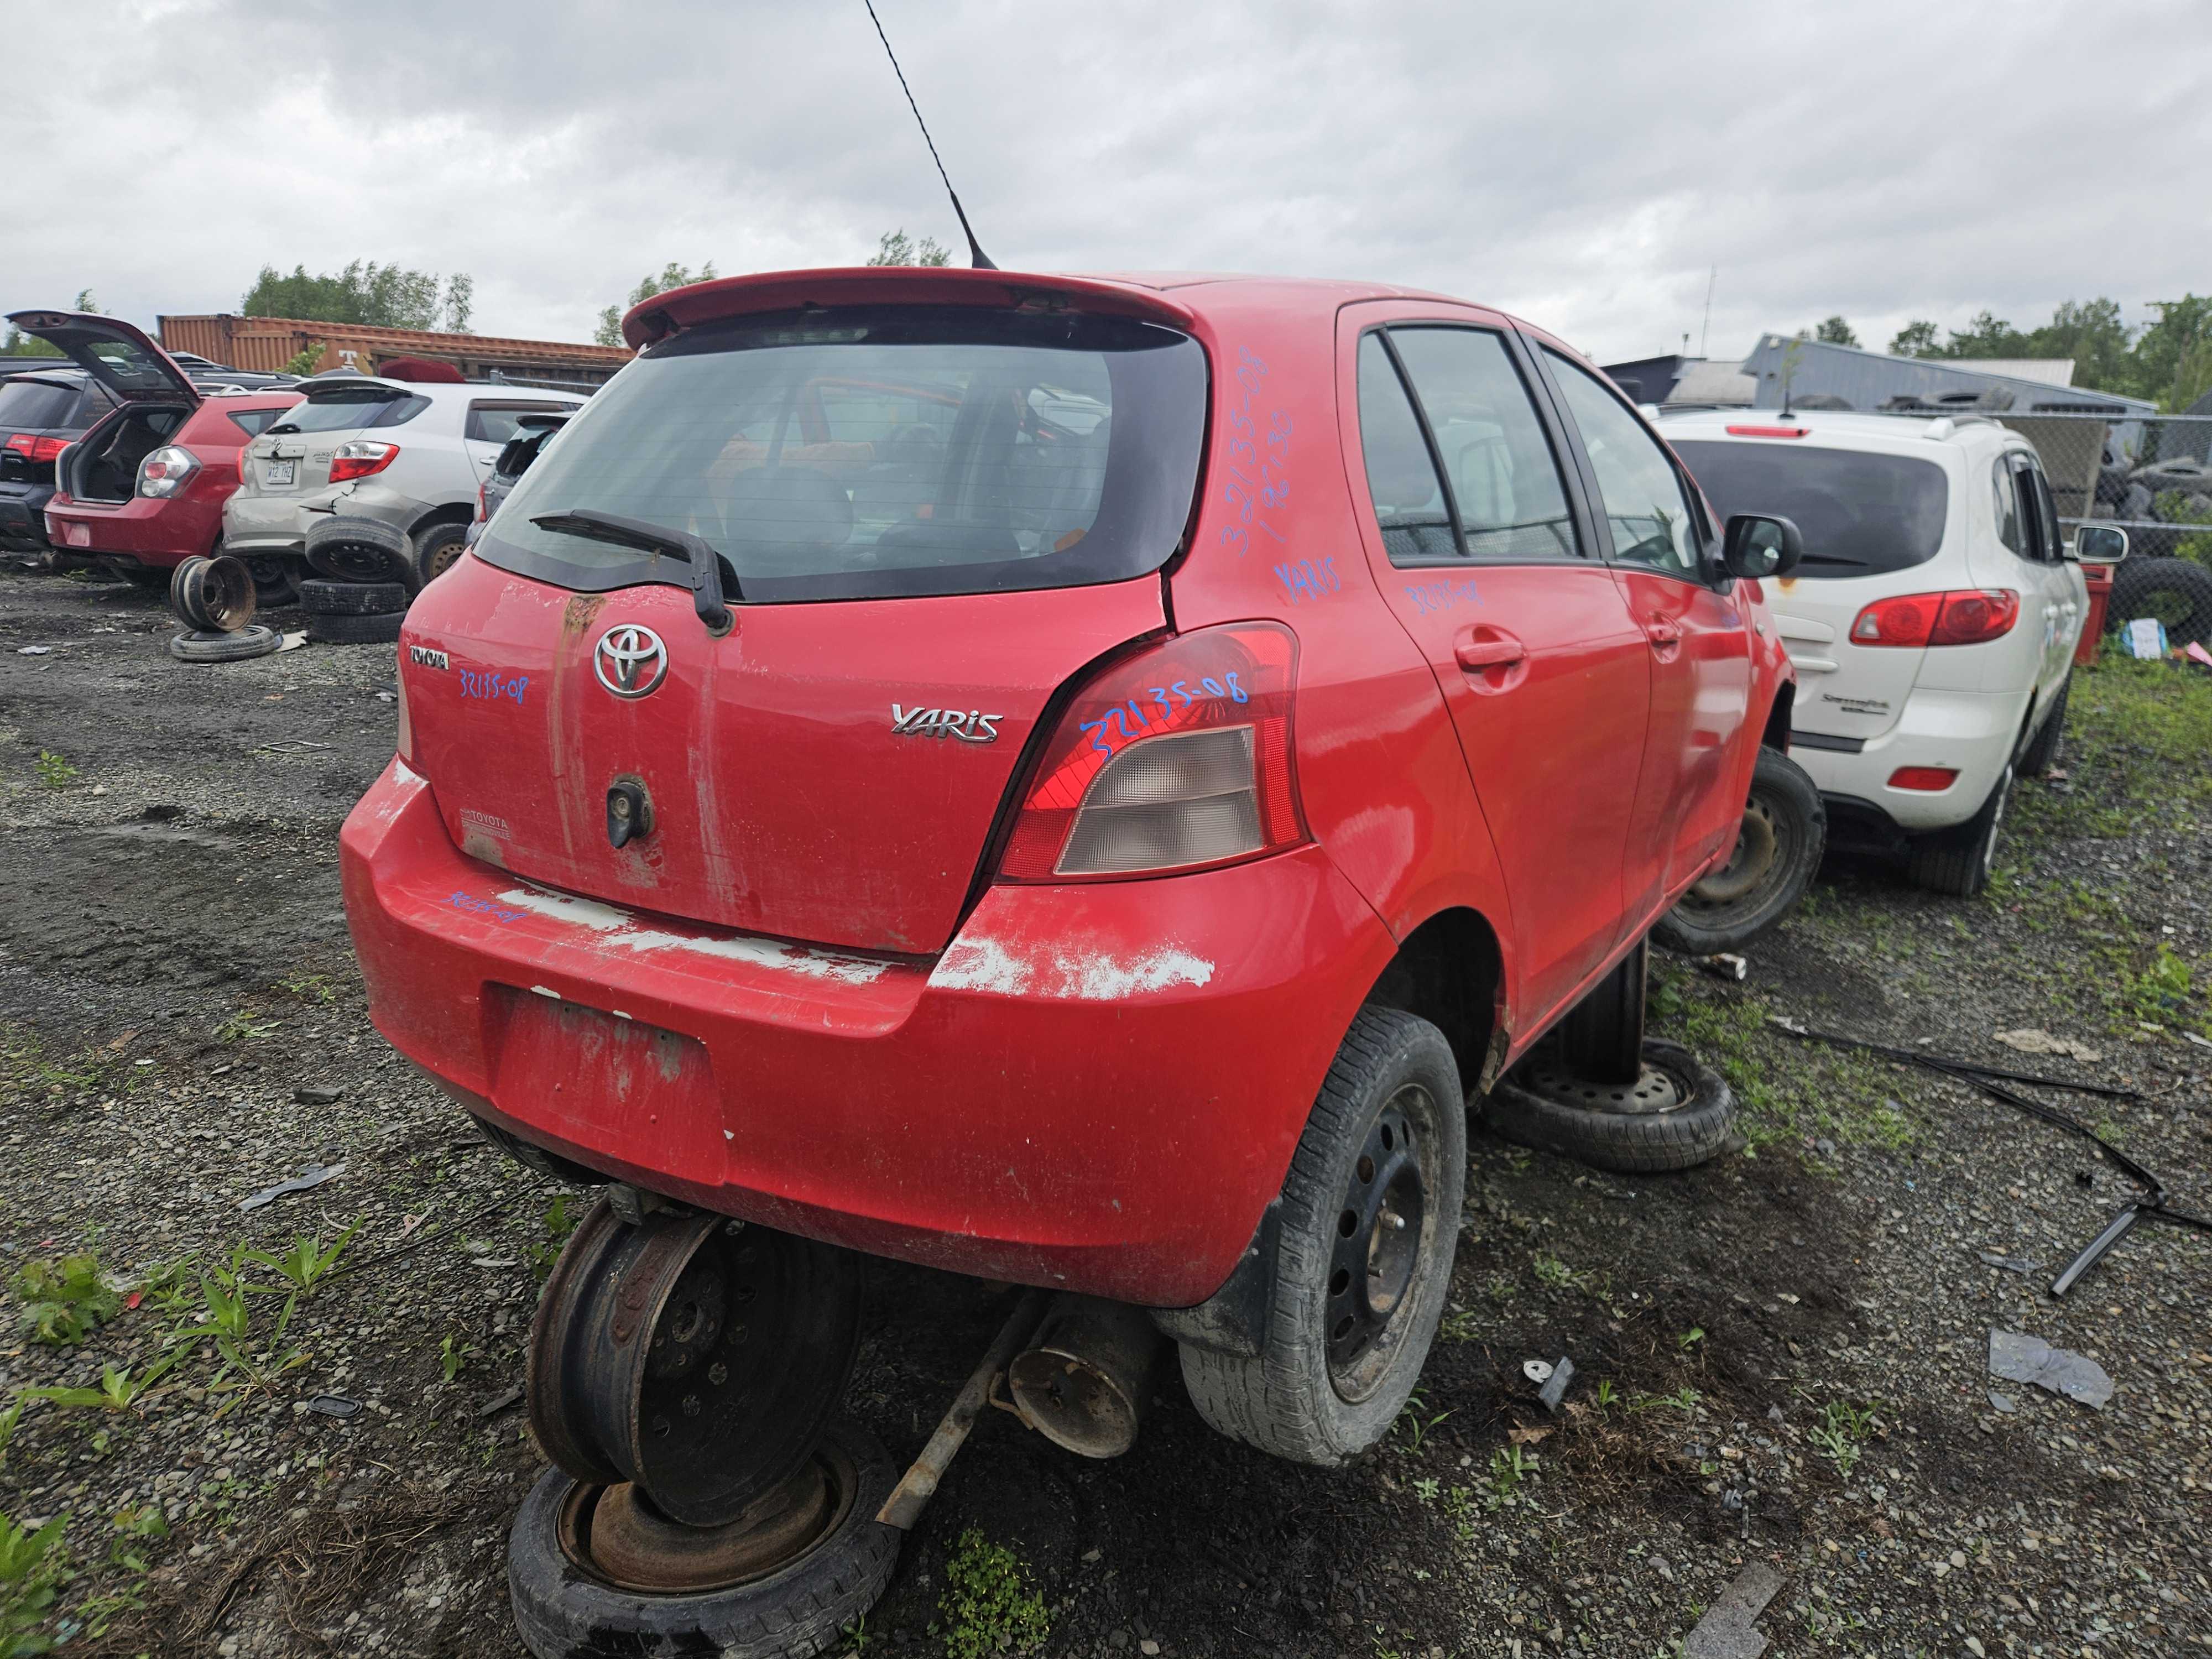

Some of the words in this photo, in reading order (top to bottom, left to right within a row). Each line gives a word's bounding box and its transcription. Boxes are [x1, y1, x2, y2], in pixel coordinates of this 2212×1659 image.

[1221, 346, 1268, 557] 32135-08
[1274, 557, 1340, 604] YARIS
[409, 645, 449, 670] TOYOTA
[460, 669, 529, 705] 32135-08
[1079, 671, 1248, 763] 32135-08
[471, 810, 508, 828] TOYOTA
